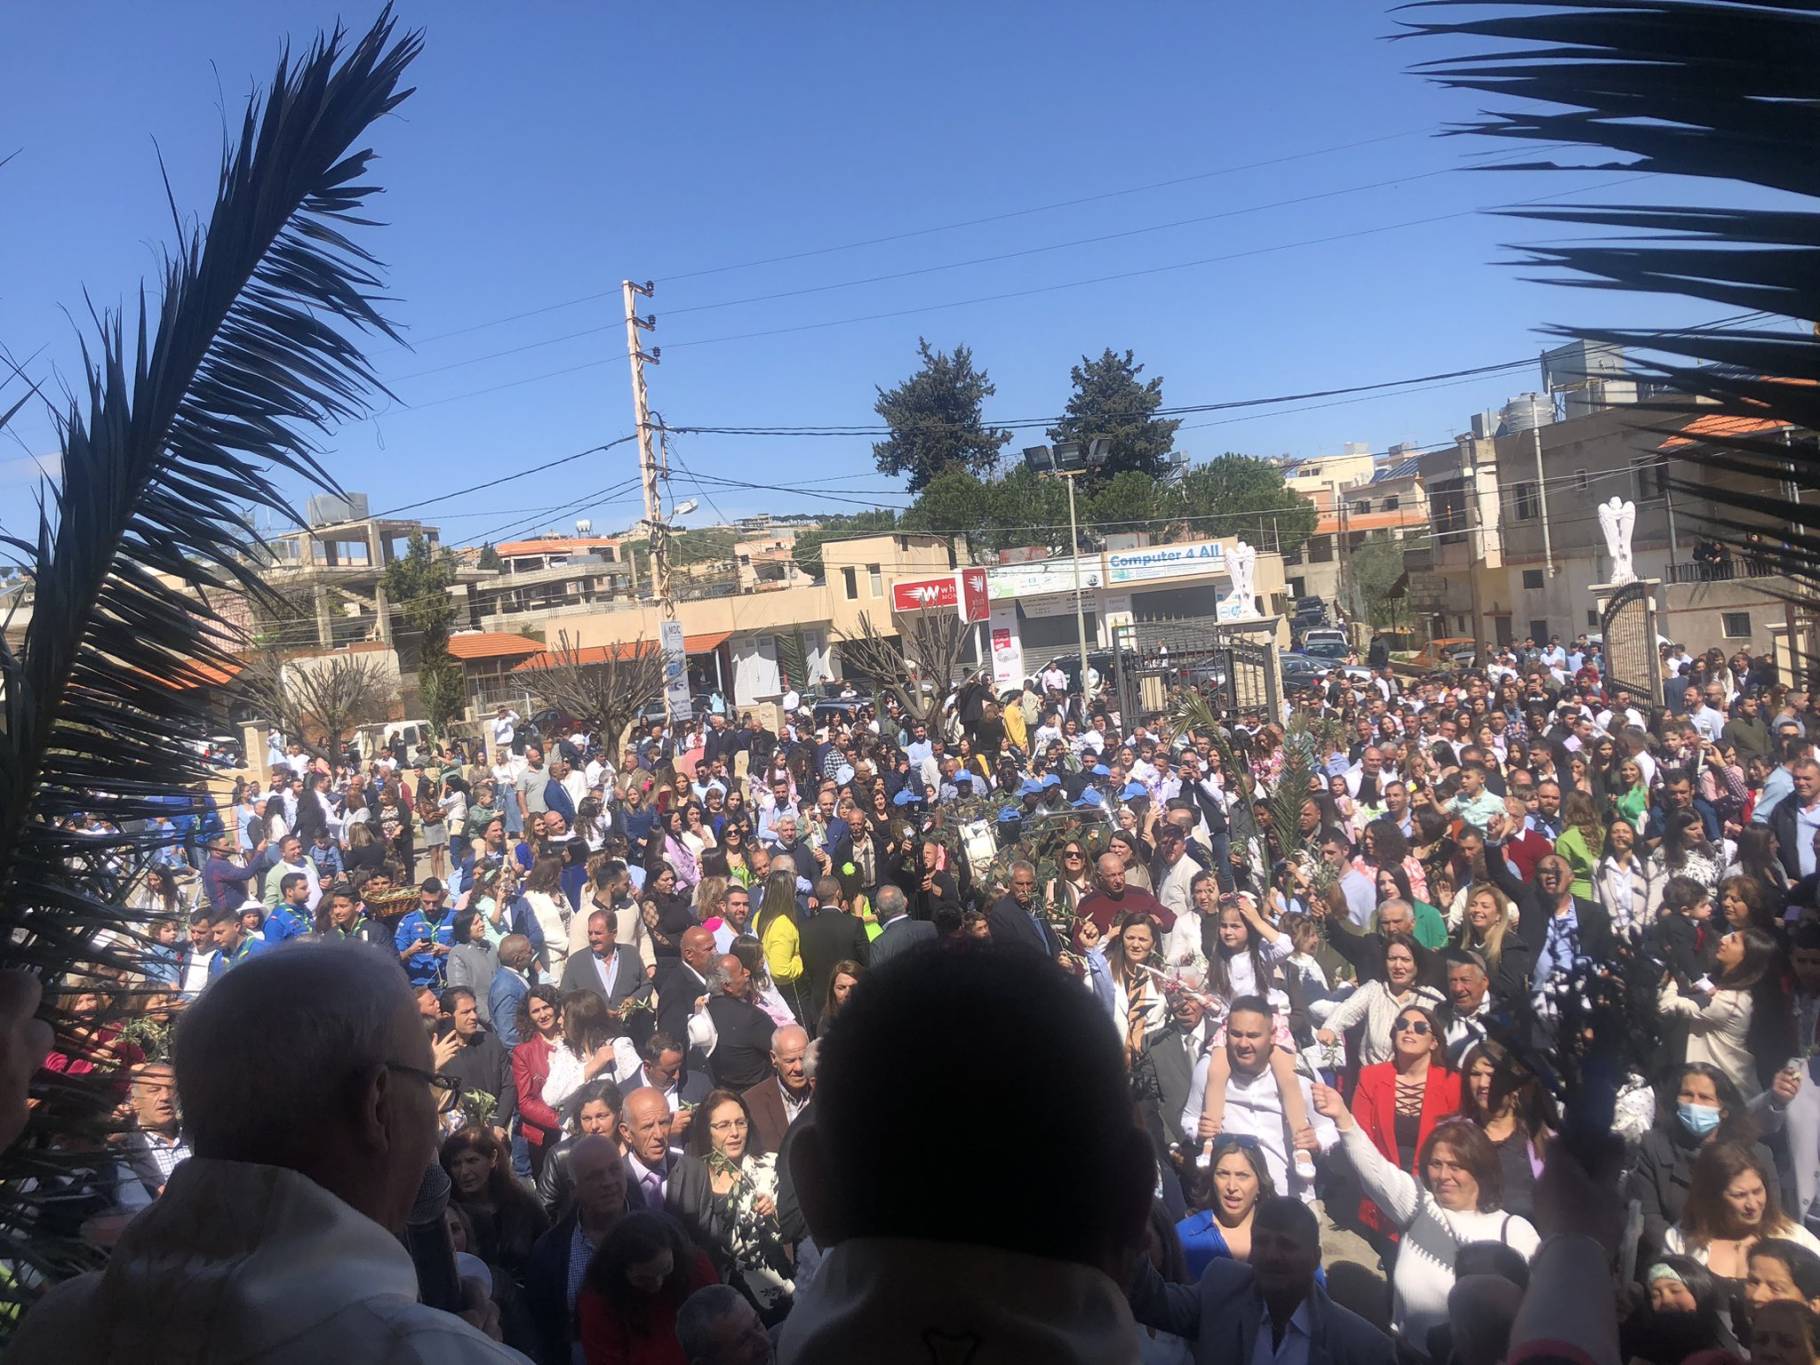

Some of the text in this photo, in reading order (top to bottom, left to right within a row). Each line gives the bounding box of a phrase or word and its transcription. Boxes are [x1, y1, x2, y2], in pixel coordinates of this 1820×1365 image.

[1110, 544, 1220, 567] Computer 4 All
